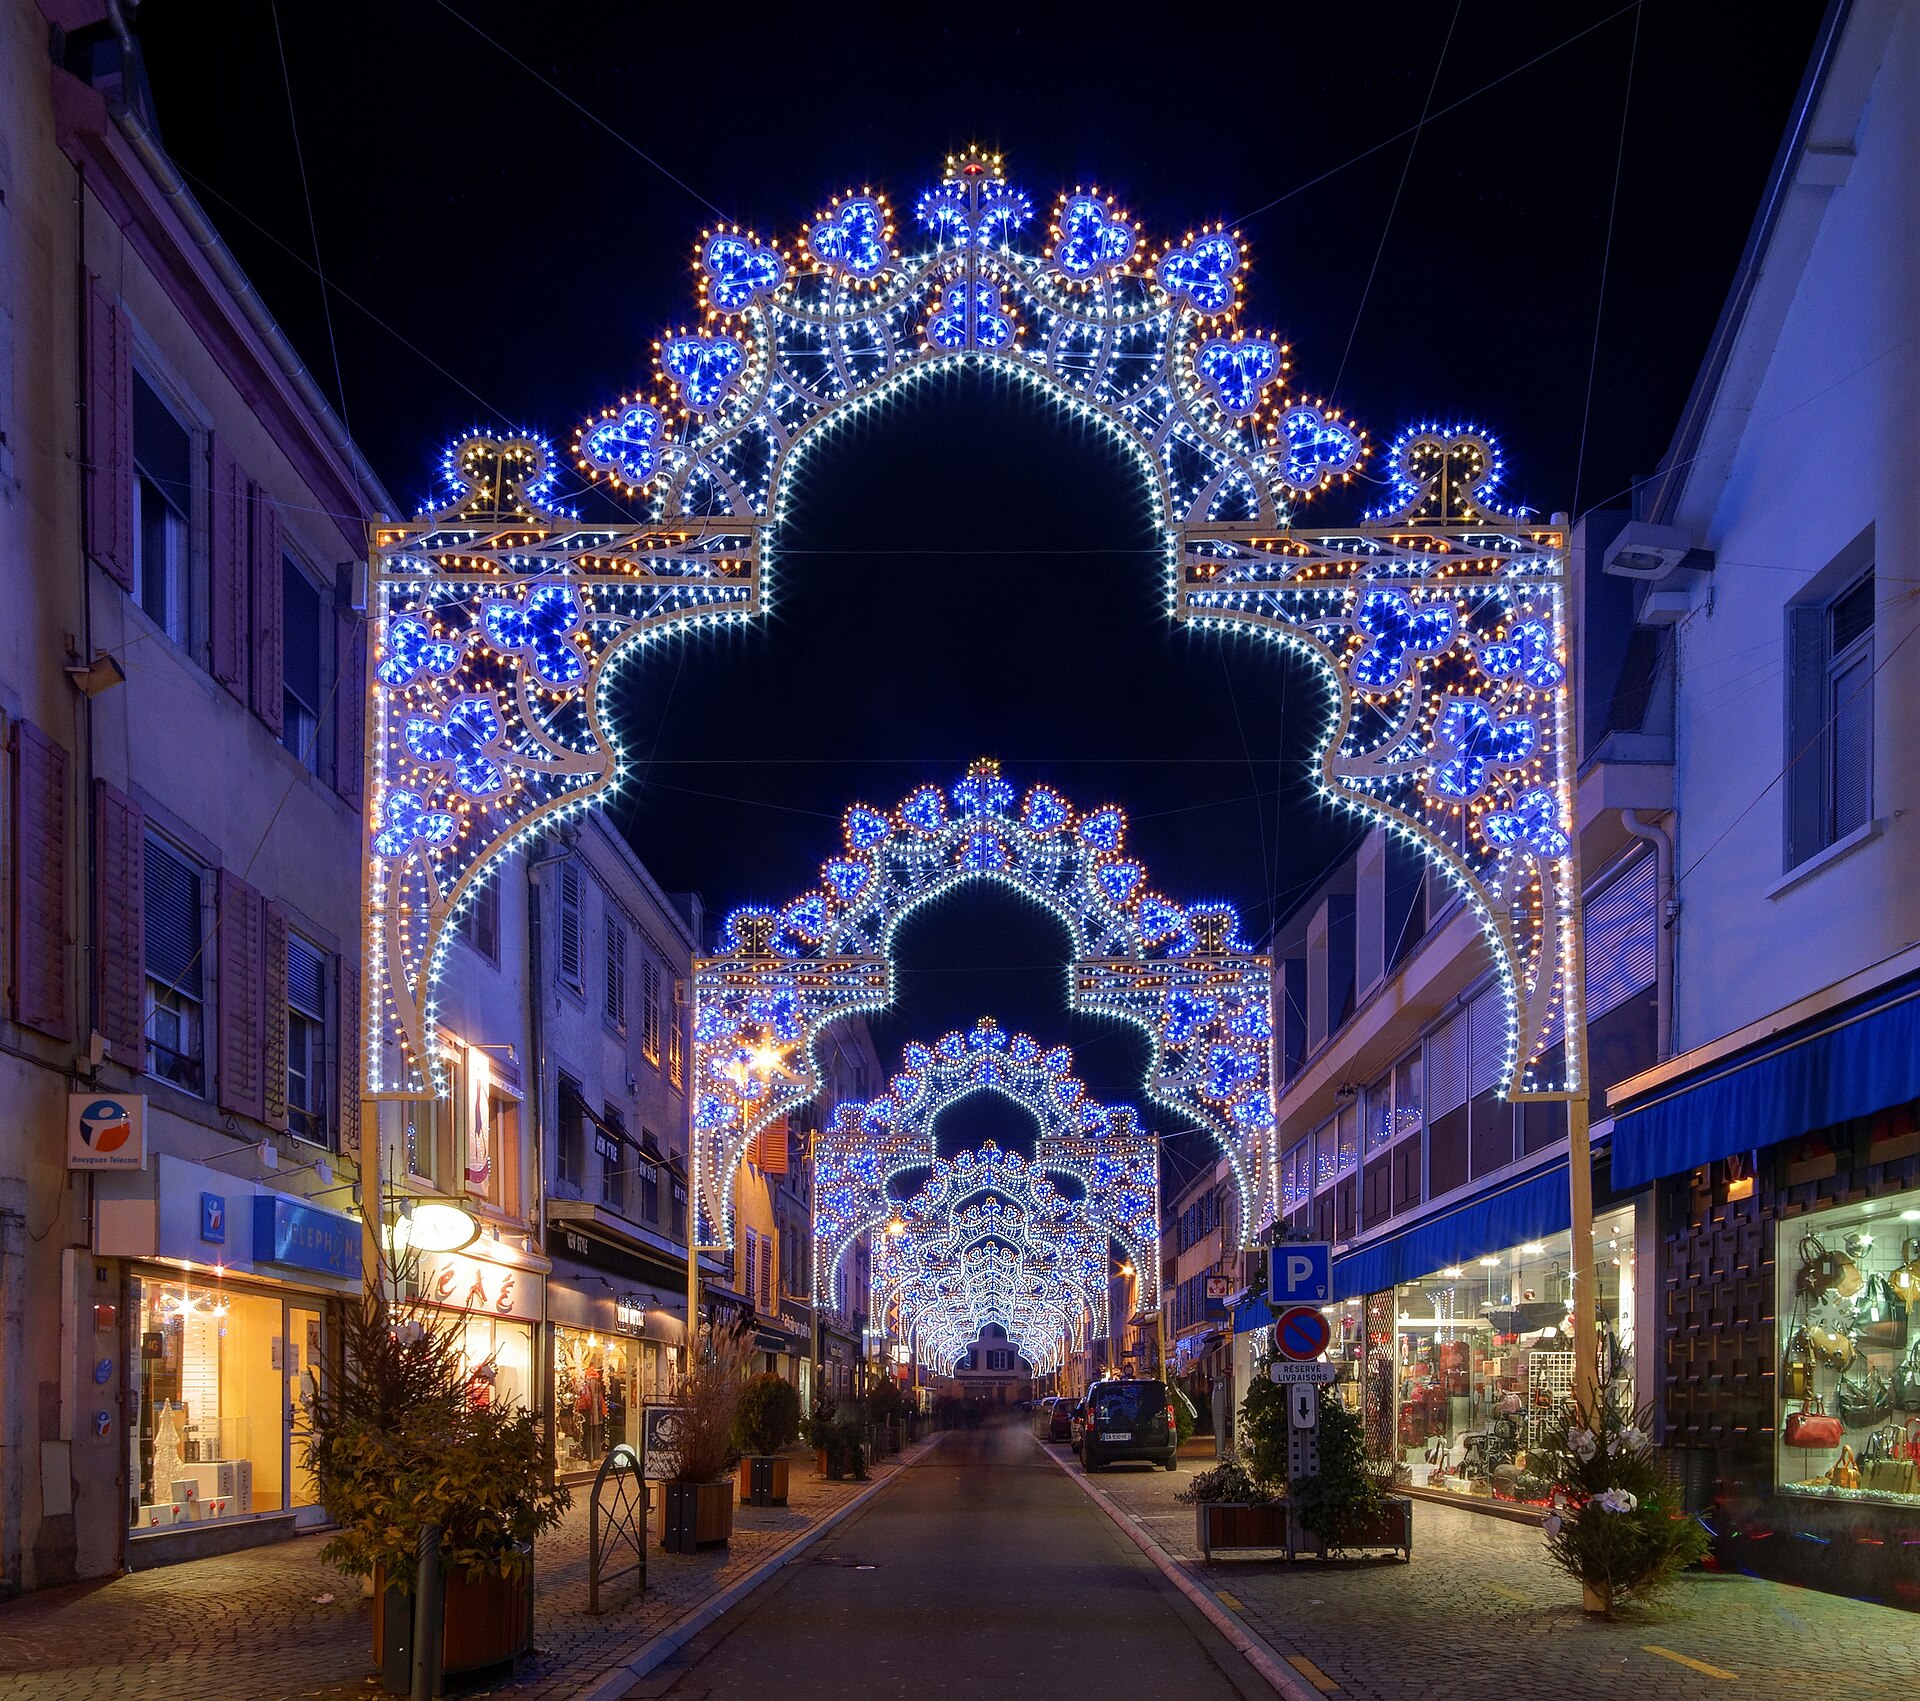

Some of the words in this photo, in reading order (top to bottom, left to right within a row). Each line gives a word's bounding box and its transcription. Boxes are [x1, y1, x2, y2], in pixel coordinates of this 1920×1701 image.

[71, 1156, 107, 1164] Bouygues
[1287, 1255, 1313, 1292] P
[1283, 1364, 1321, 1373] RÉSERVÉ
[1278, 1373, 1328, 1382] LIVRAISONS
